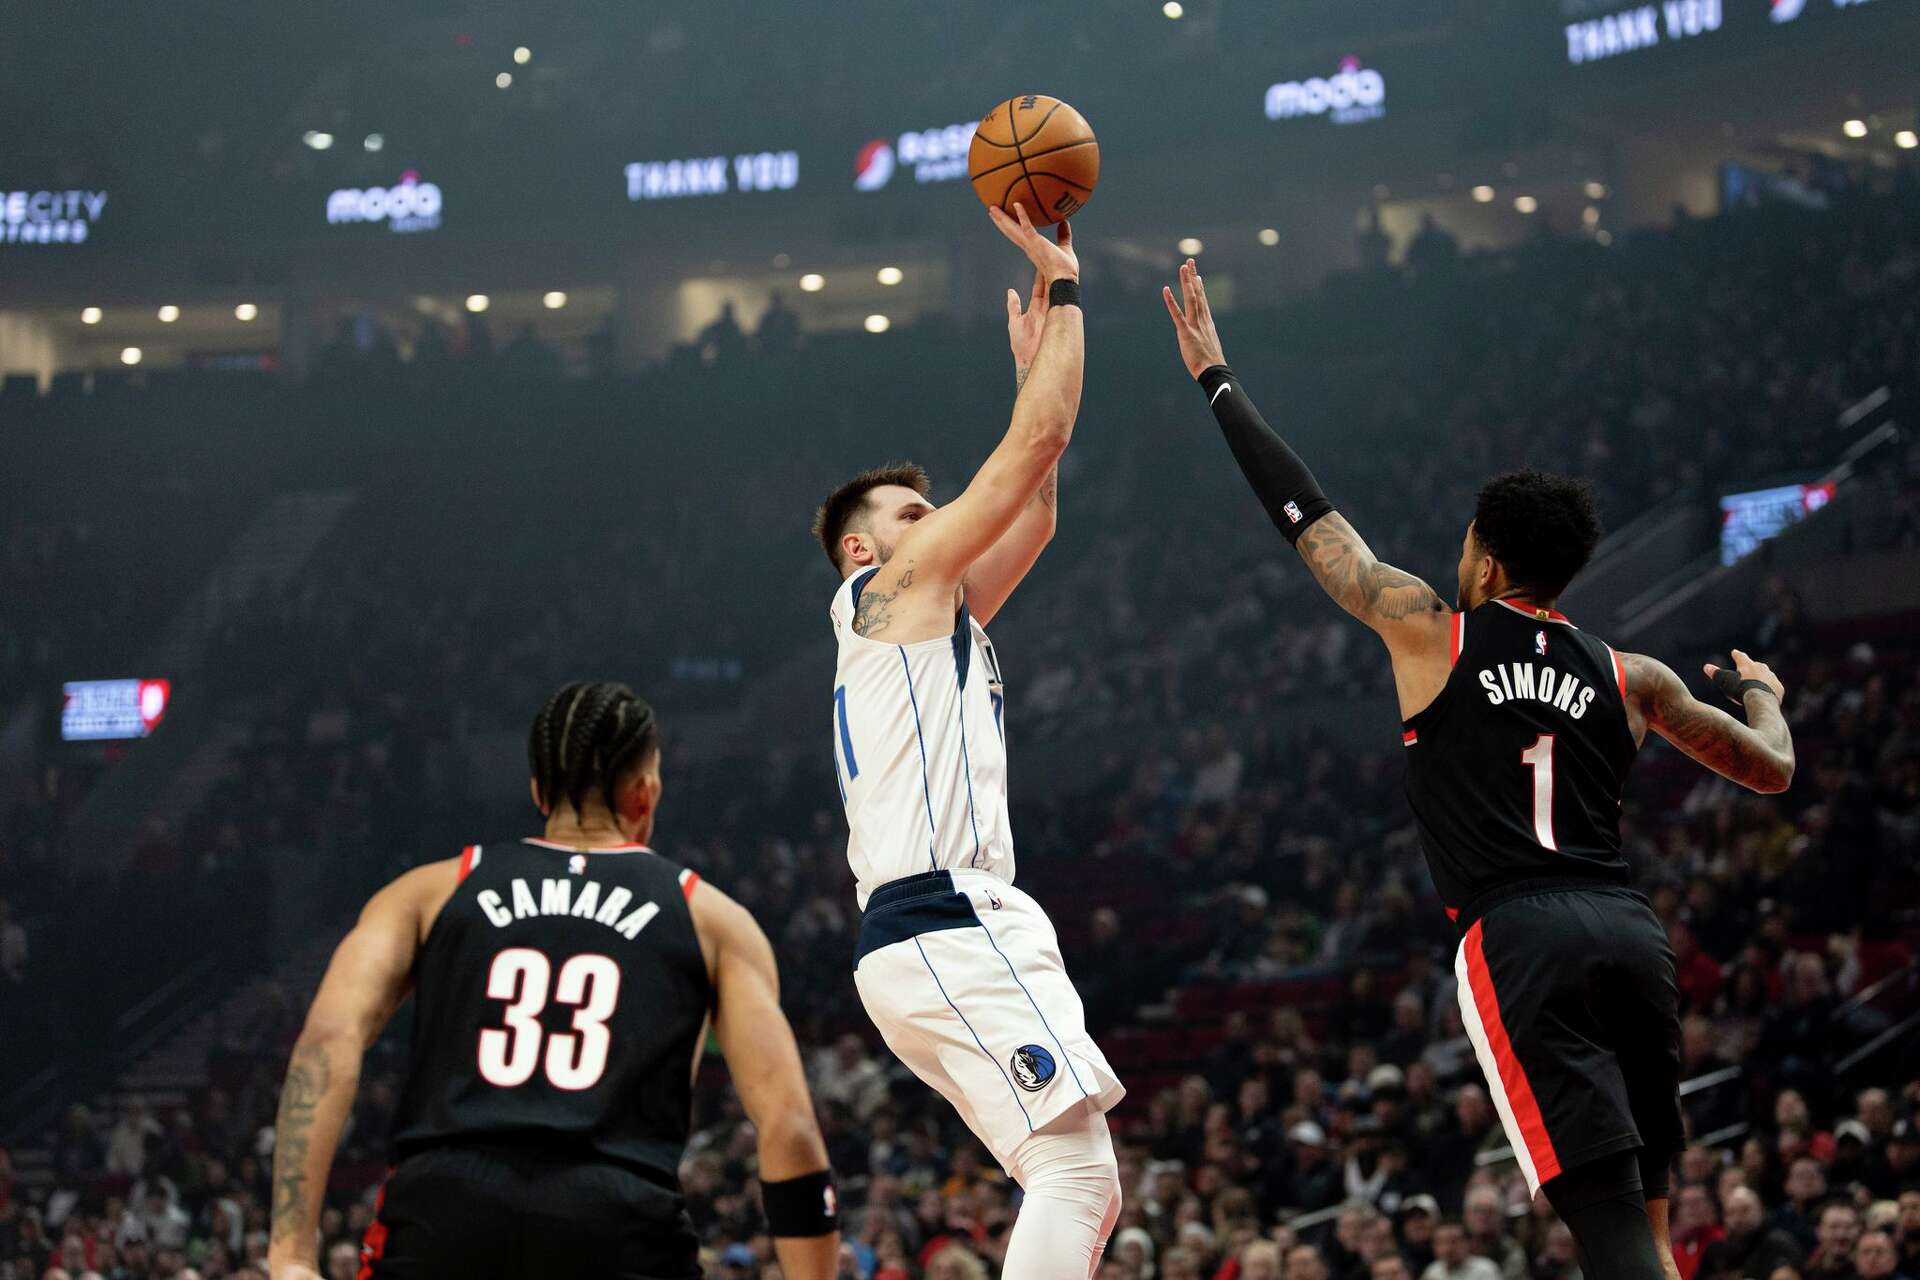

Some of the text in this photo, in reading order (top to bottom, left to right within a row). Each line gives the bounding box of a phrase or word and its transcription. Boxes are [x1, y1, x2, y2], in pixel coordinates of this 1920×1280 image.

[1565, 0, 1723, 64] THANK YOU
[1264, 63, 1385, 119] moda
[326, 175, 442, 225] moda
[624, 151, 798, 201] THANK YOU
[1478, 662, 1596, 720] SIMONS
[1520, 732, 1558, 851] 1
[477, 878, 661, 941] CAMARA
[477, 946, 622, 1092] 33
